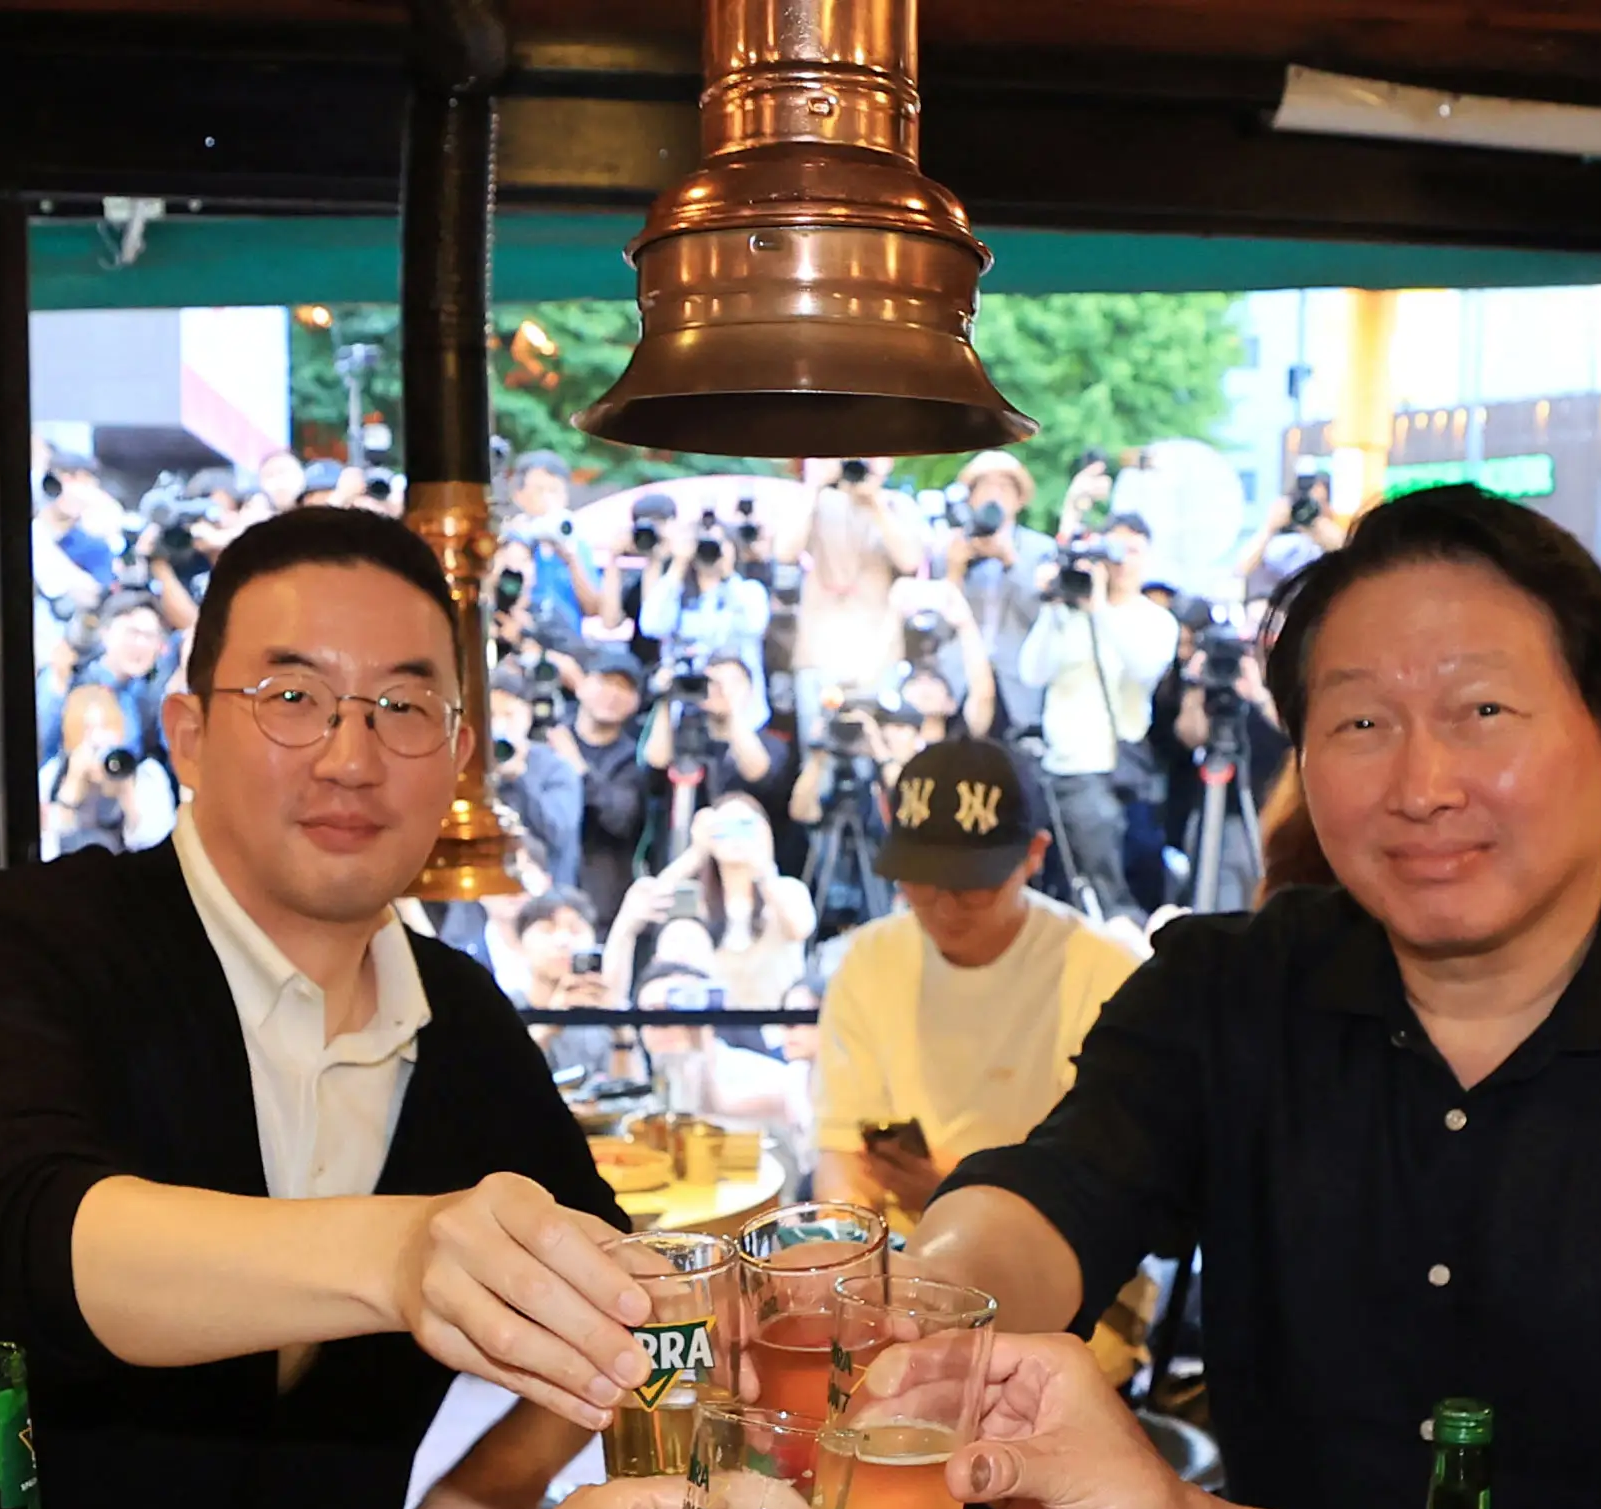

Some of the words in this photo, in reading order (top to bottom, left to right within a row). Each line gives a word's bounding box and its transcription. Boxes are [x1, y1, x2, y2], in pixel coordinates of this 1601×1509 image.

[896, 777, 935, 829] NY
[954, 780, 1003, 835] NY
[633, 1326, 714, 1370] RRA
